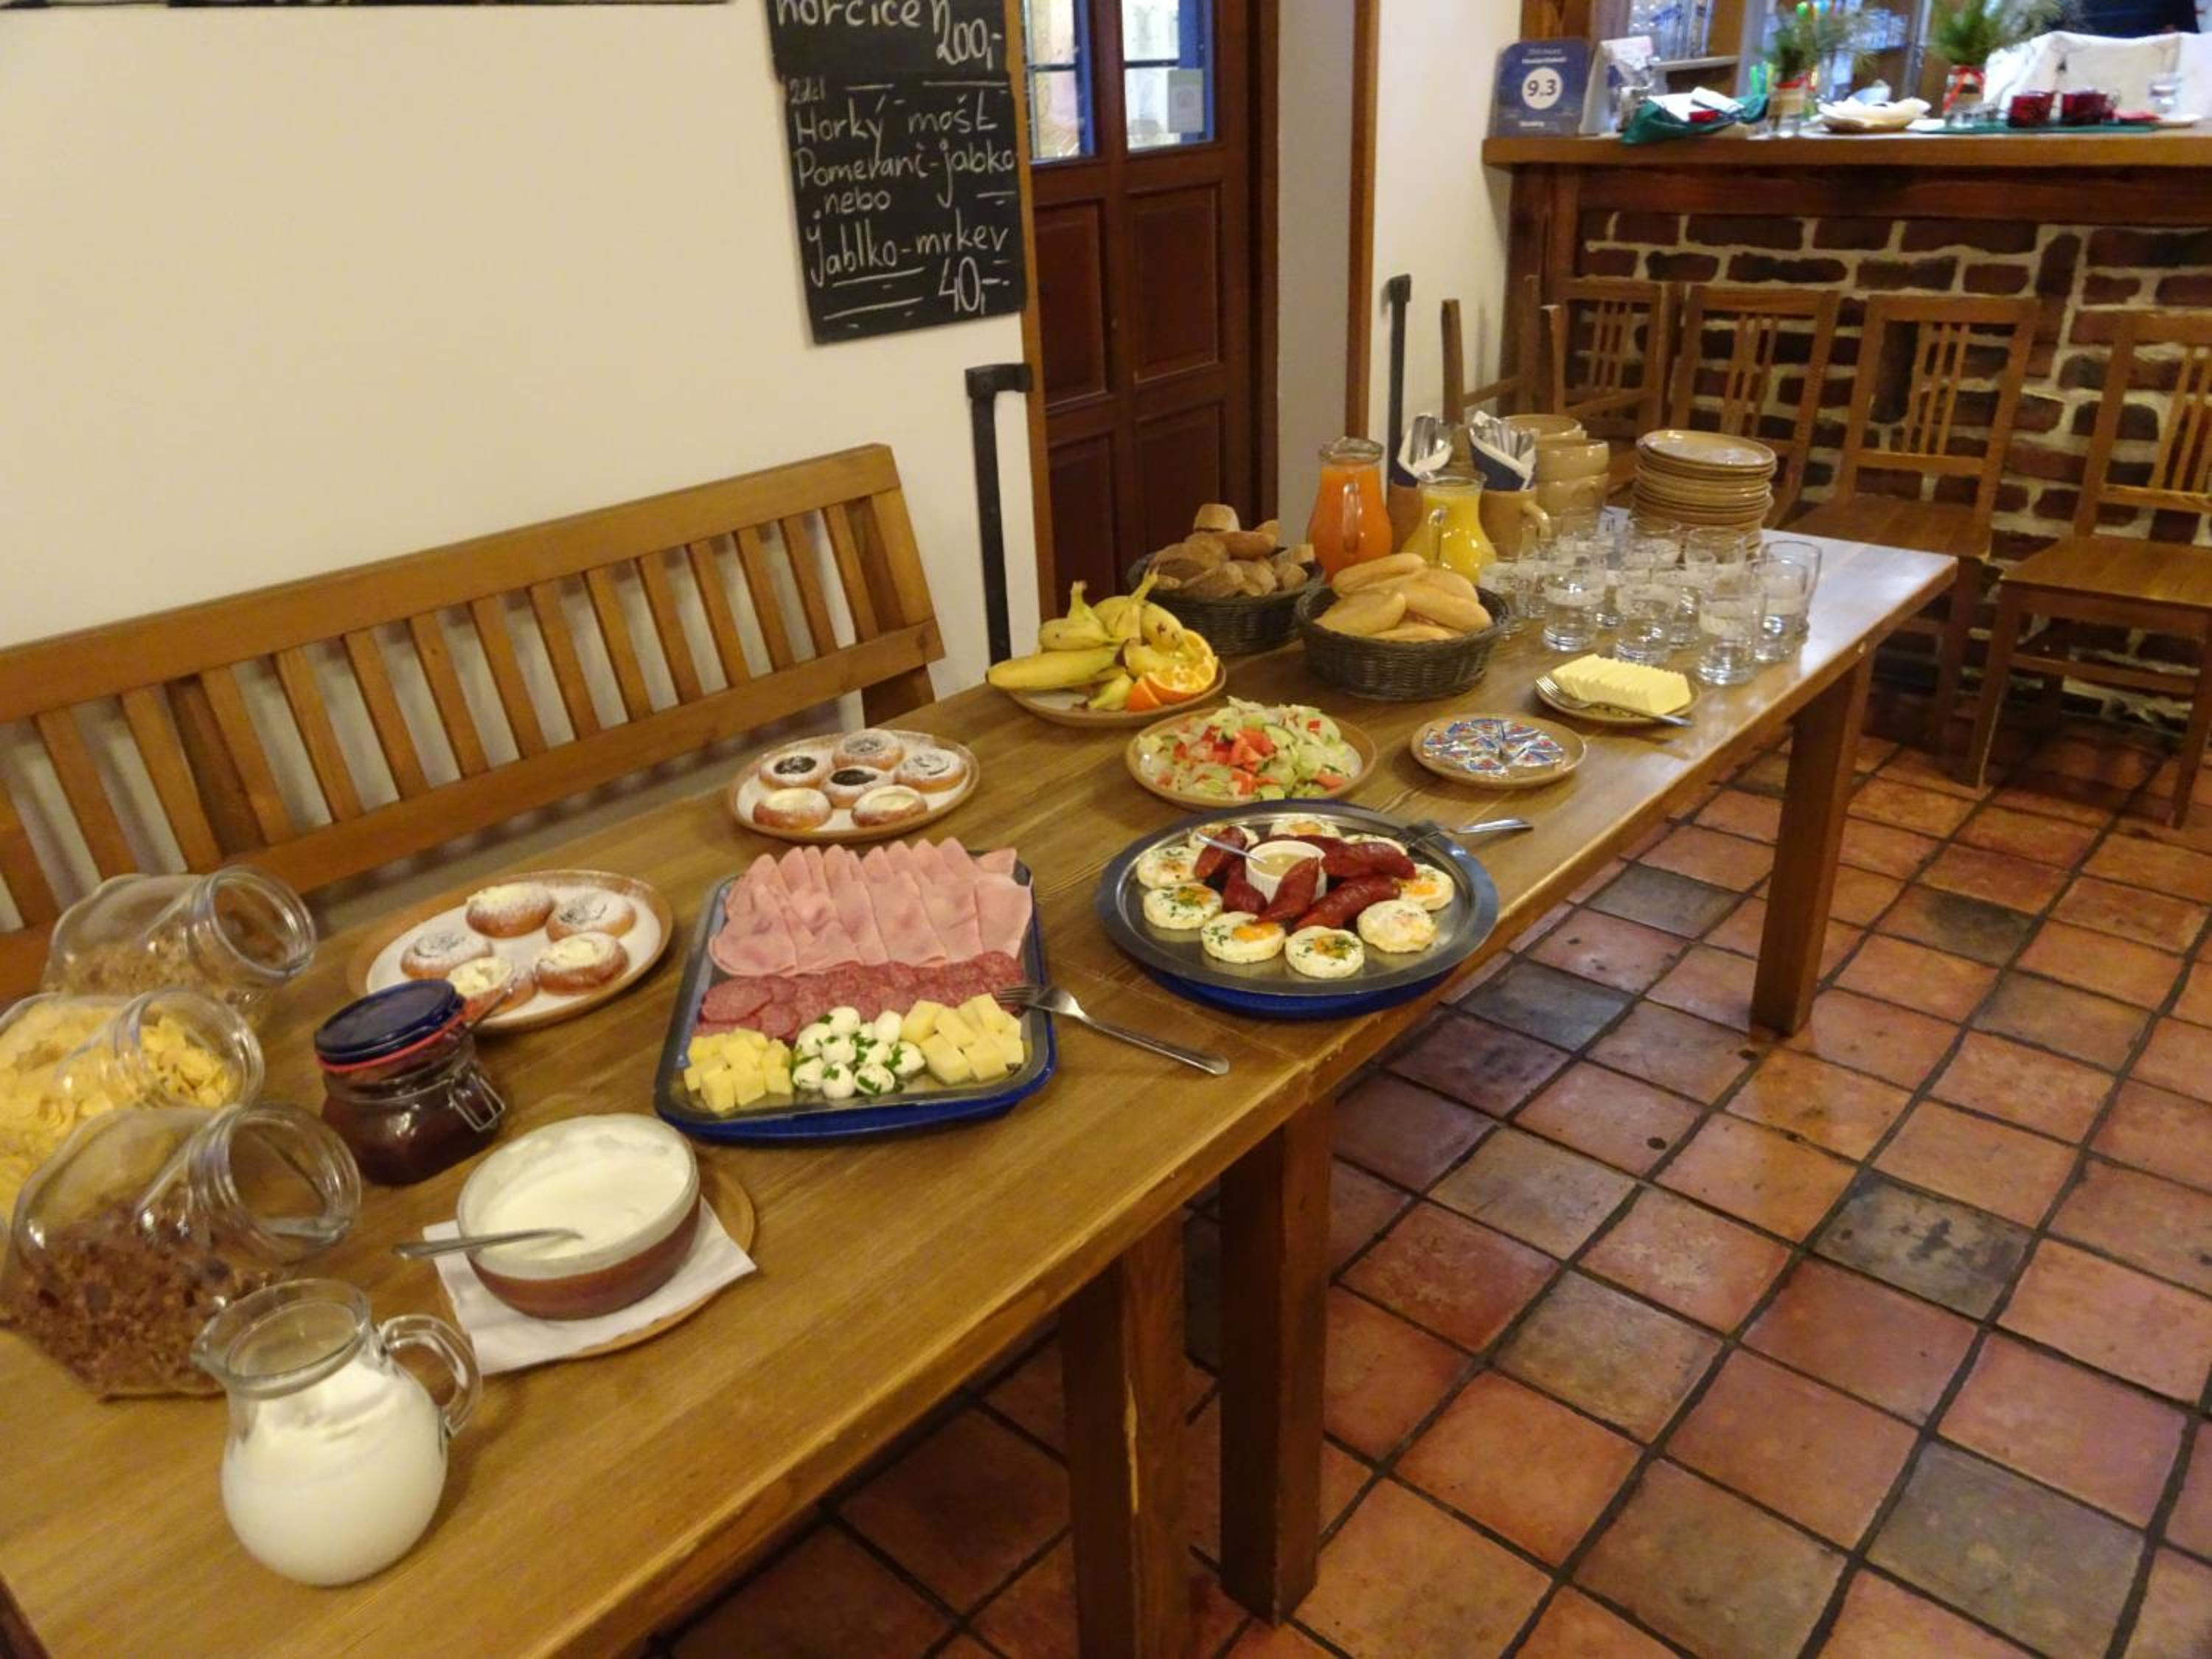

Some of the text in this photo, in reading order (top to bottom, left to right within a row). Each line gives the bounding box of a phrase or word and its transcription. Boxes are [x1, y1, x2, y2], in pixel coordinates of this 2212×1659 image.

[1528, 79, 1557, 97] 9.3
[794, 93, 886, 164] Horký
[824, 186, 891, 214] nebo
